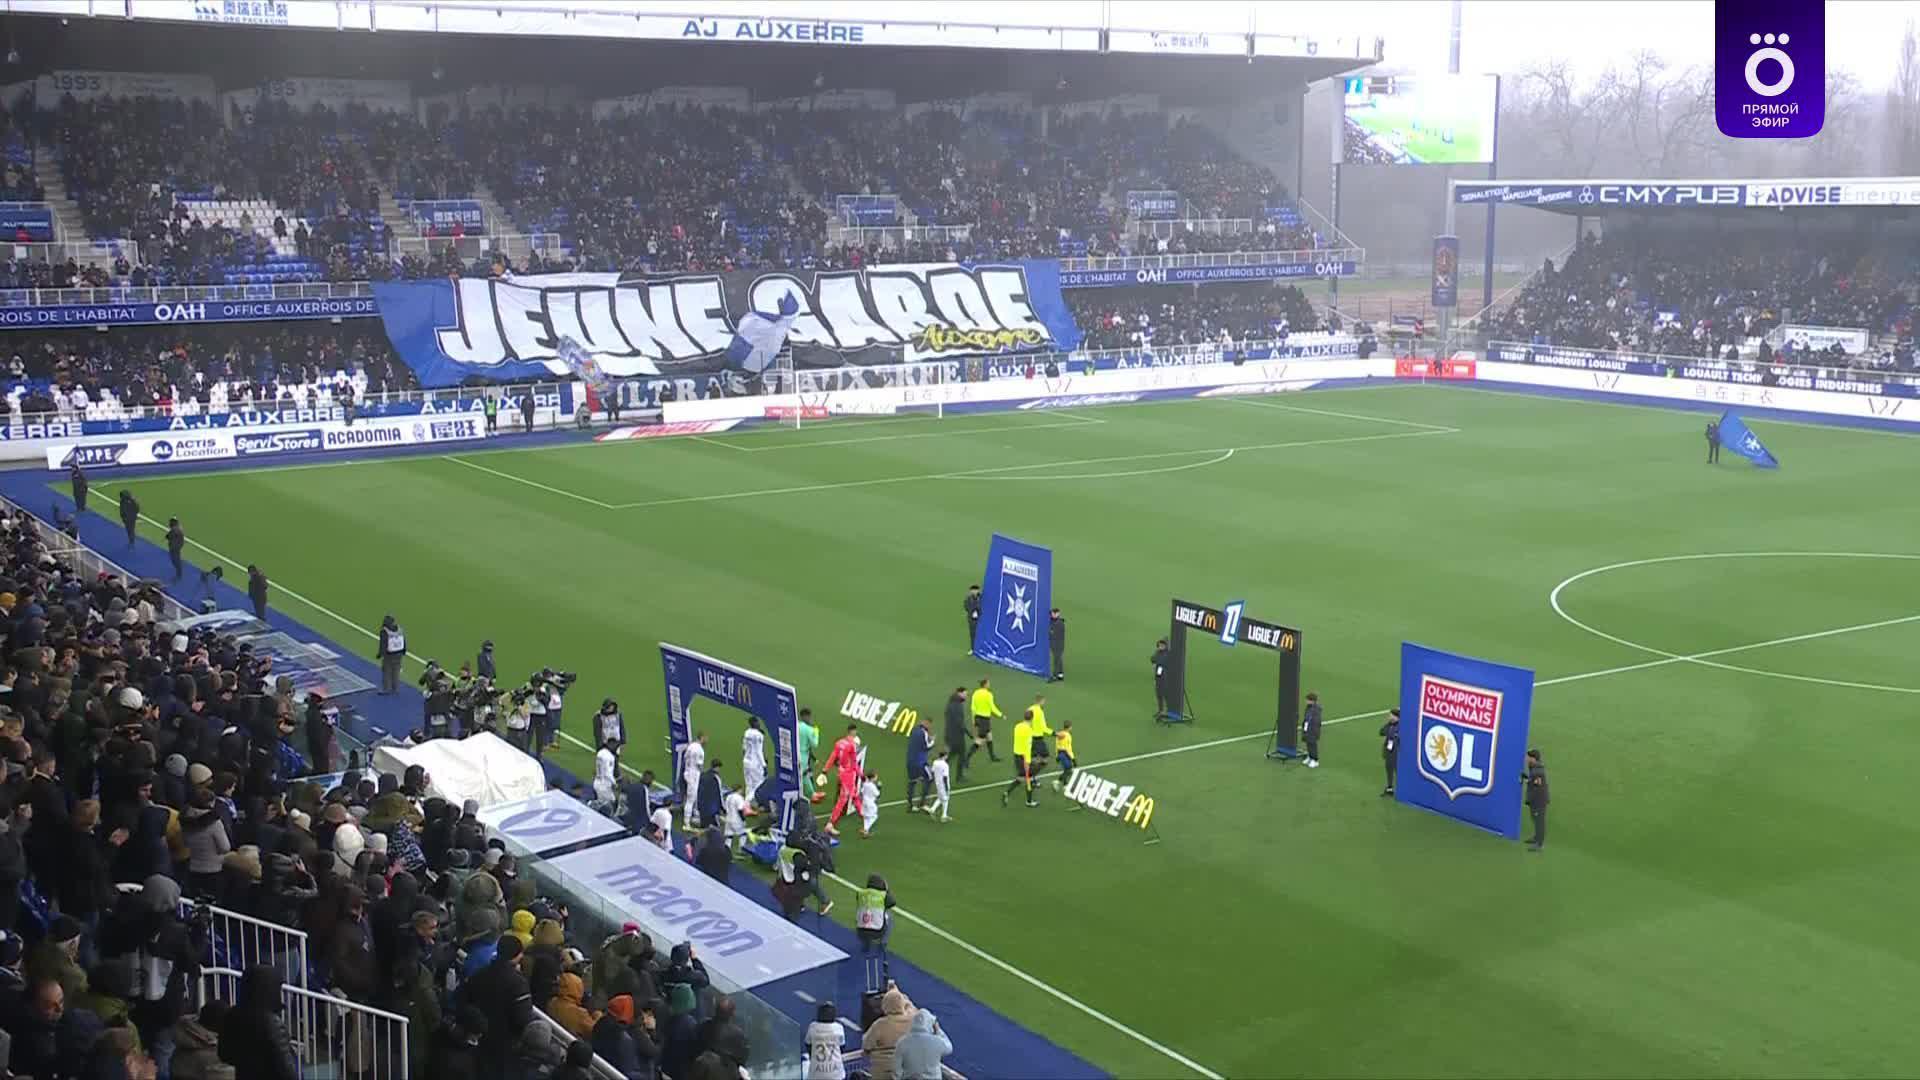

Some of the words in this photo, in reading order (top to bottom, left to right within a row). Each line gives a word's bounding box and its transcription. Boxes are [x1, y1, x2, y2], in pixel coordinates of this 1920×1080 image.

[683, 20, 718, 37] AJ
[736, 22, 864, 42] AUXERRE
[54, 75, 100, 91] 1993
[1676, 186, 1740, 203] PUB
[1766, 186, 1841, 203] ADVISE
[1070, 276, 1083, 284] DE
[1086, 273, 1127, 283] L'HABITAT
[1137, 269, 1167, 282] OAH
[1177, 270, 1205, 279] OFFICE
[1208, 267, 1253, 278] AUXERROIS
[1256, 267, 1267, 276] DE
[1269, 265, 1307, 276] L'HABITAT
[1315, 262, 1343, 275] OAH
[39, 310, 57, 321] DE
[65, 308, 137, 321] L'HABITAT
[155, 303, 206, 320] OAH
[223, 304, 272, 316] OFFICE
[275, 301, 351, 314] AUXERROIS
[356, 300, 373, 311] DE
[438, 277, 736, 364] JEUNE
[1588, 360, 1627, 371] LOUAULT
[1683, 367, 1728, 381] LOUAULT
[1732, 371, 1812, 388] TECHNOGIES
[1815, 379, 1882, 394] INDUSTRIES
[226, 406, 344, 428] AUXERRE
[176, 439, 216, 448] ACTIS
[328, 428, 401, 445] ACADOMIA
[176, 447, 228, 457] Location
[1427, 685, 1494, 710] OLYMPIQUE
[1426, 700, 1491, 725] LYONNAIS
[596, 863, 764, 957] macron
